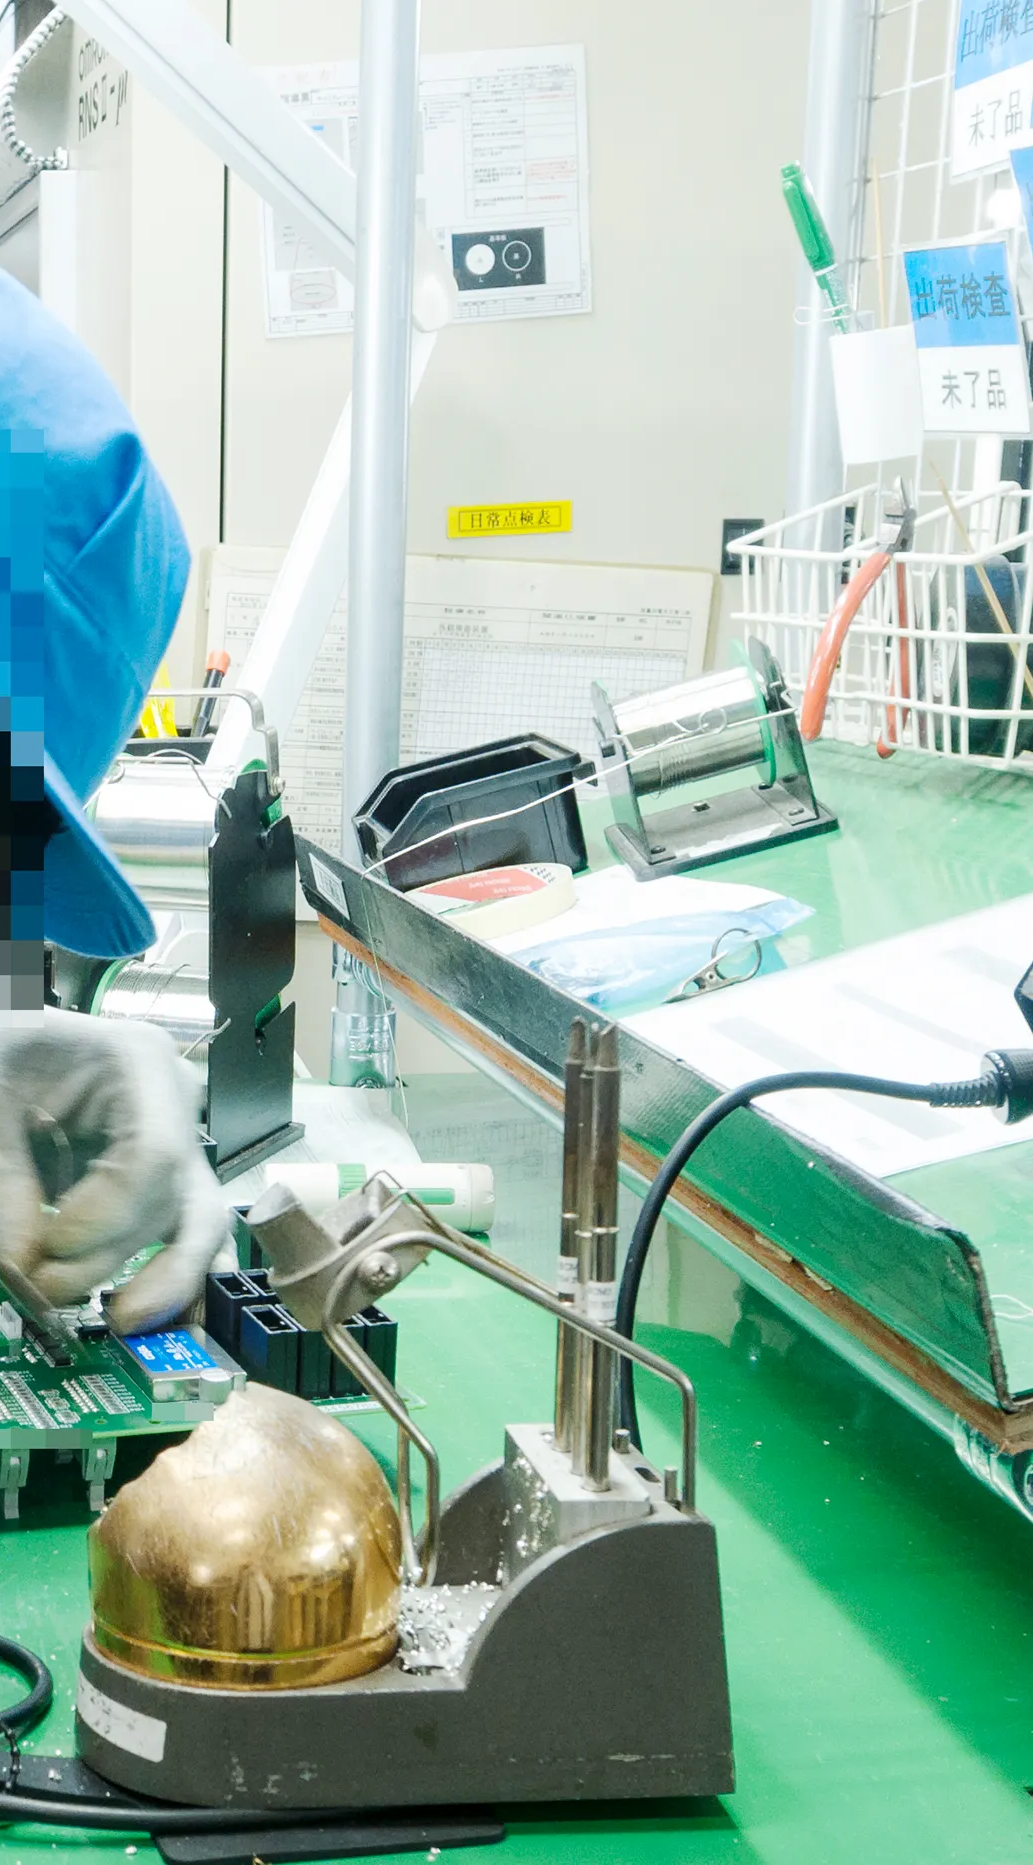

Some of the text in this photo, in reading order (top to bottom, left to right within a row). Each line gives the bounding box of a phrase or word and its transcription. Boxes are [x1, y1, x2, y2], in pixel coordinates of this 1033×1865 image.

[969, 89, 1023, 147] 未了品
[915, 271, 1011, 320] 出荷検査
[942, 369, 1006, 409] 未了品
[470, 509, 551, 529] 日常点検表
